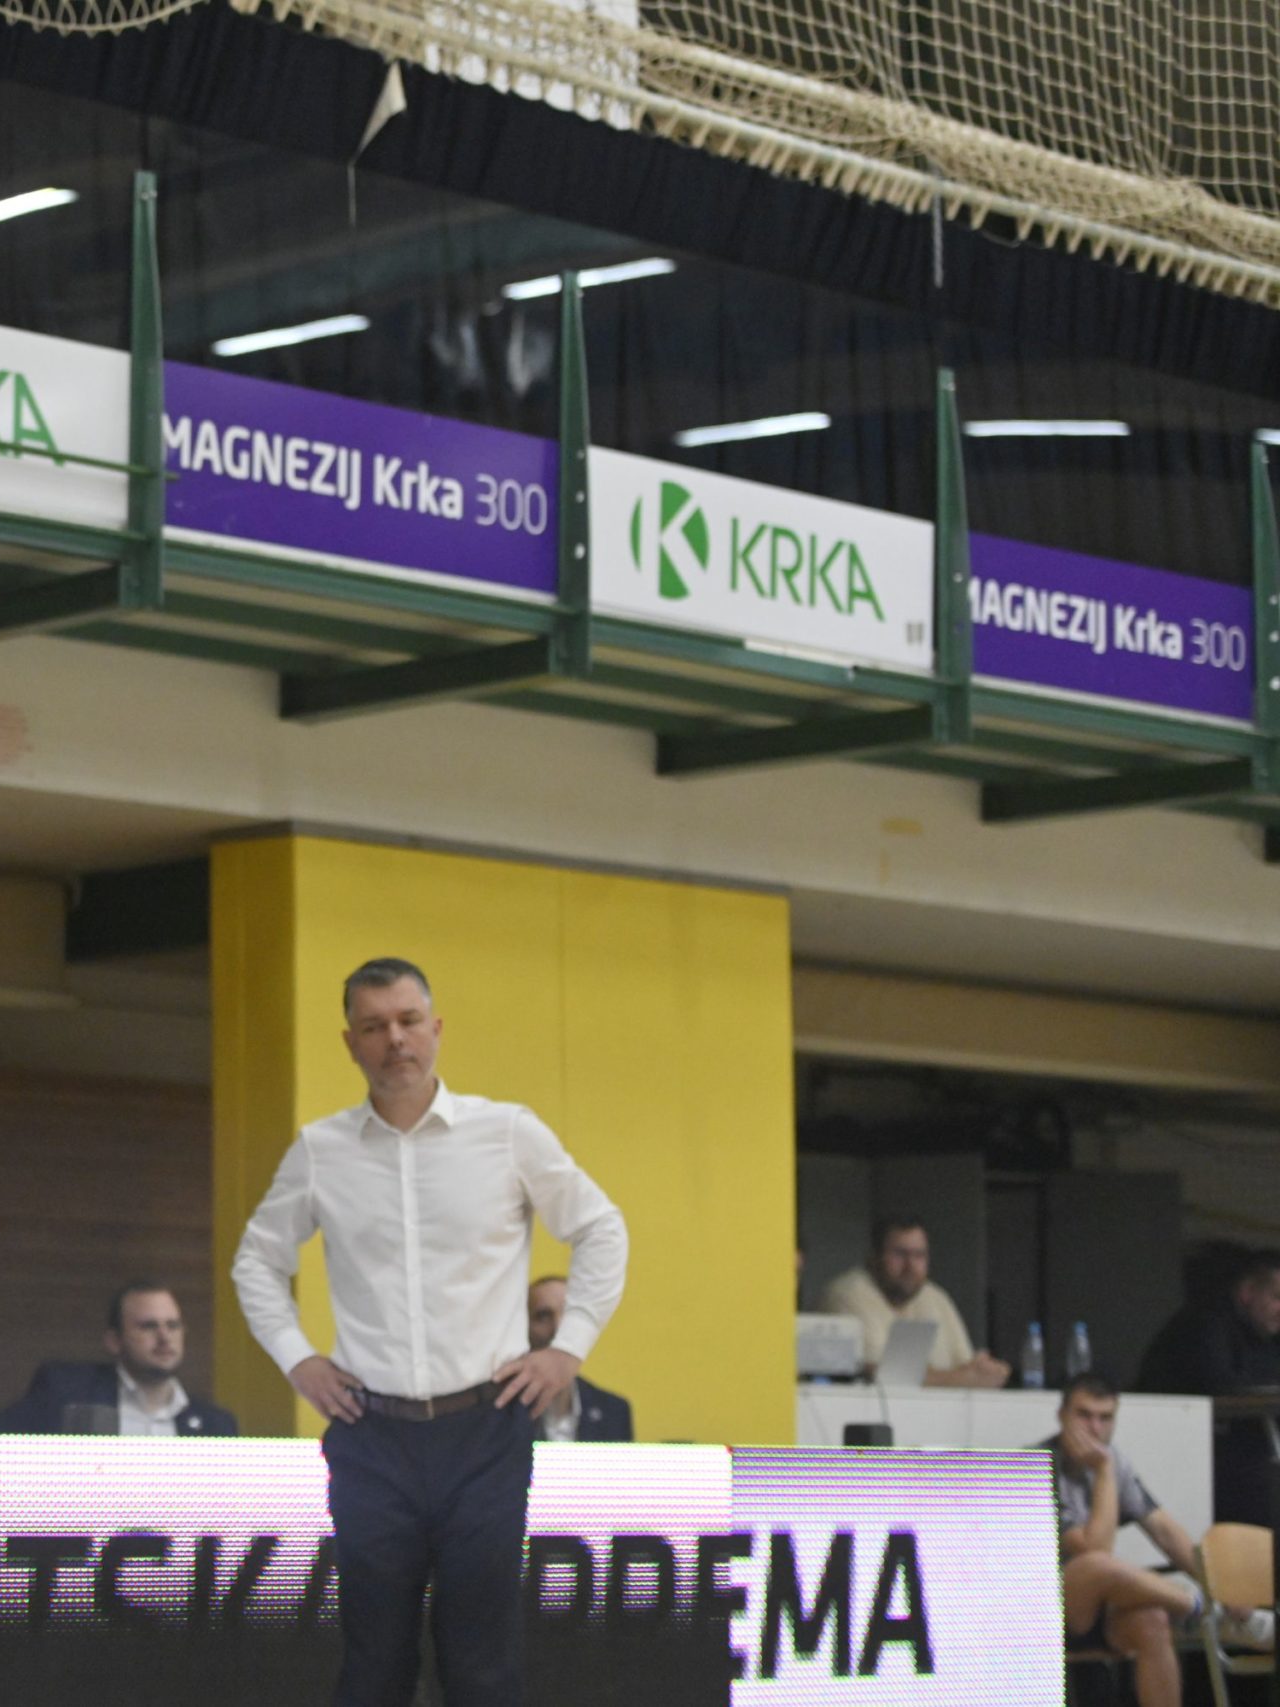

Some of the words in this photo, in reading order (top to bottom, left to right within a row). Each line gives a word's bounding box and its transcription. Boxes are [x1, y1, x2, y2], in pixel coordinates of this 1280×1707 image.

[161, 412, 362, 510] MAGNEZIJ
[372, 454, 464, 521] Krka
[475, 473, 548, 535] 300
[730, 516, 885, 623] KRKA
[1113, 604, 1184, 660] Krka
[1190, 618, 1247, 672] 300
